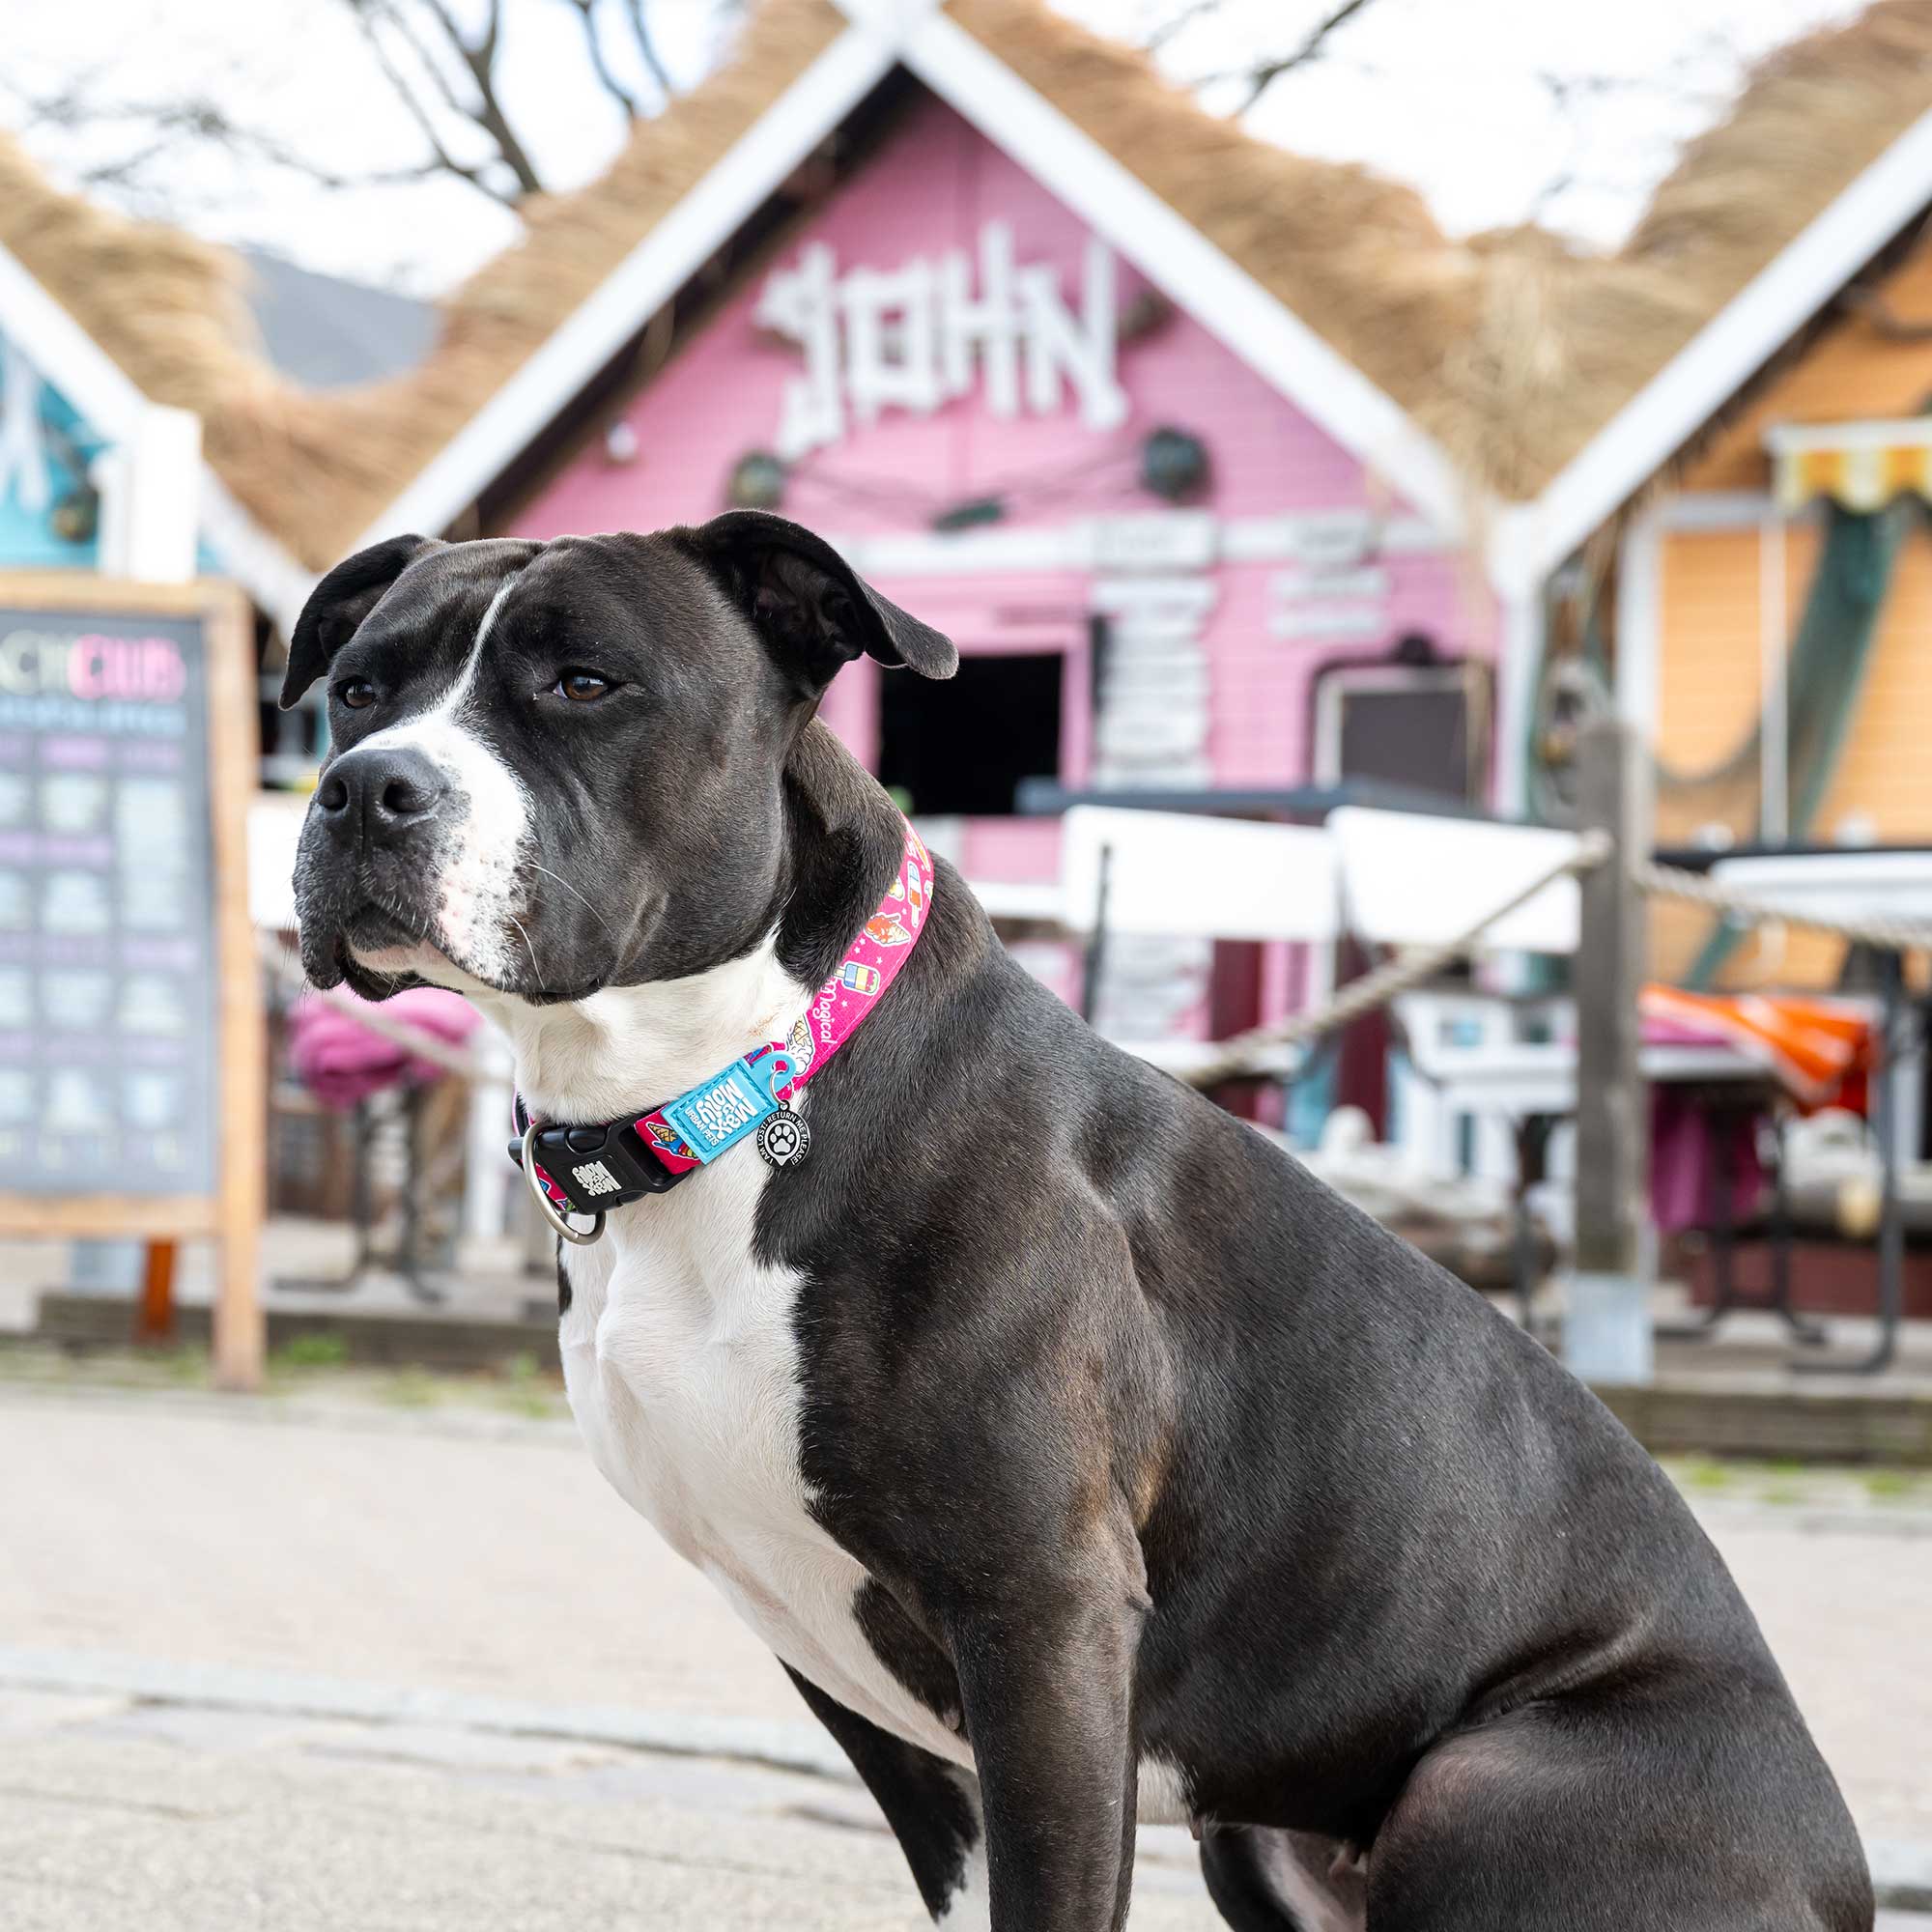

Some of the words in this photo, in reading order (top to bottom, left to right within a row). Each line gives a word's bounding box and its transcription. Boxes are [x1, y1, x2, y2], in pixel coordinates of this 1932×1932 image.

[755, 221, 1128, 461] JOHN
[812, 976, 838, 1044] Magical
[696, 1078, 744, 1124] Molly
[709, 1097, 758, 1140] Max
[684, 1107, 706, 1131] URBAN
[702, 1128, 720, 1147] PETS
[759, 1147, 771, 1161] AM
[766, 1111, 797, 1123] RETURN
[795, 1120, 807, 1133] ME
